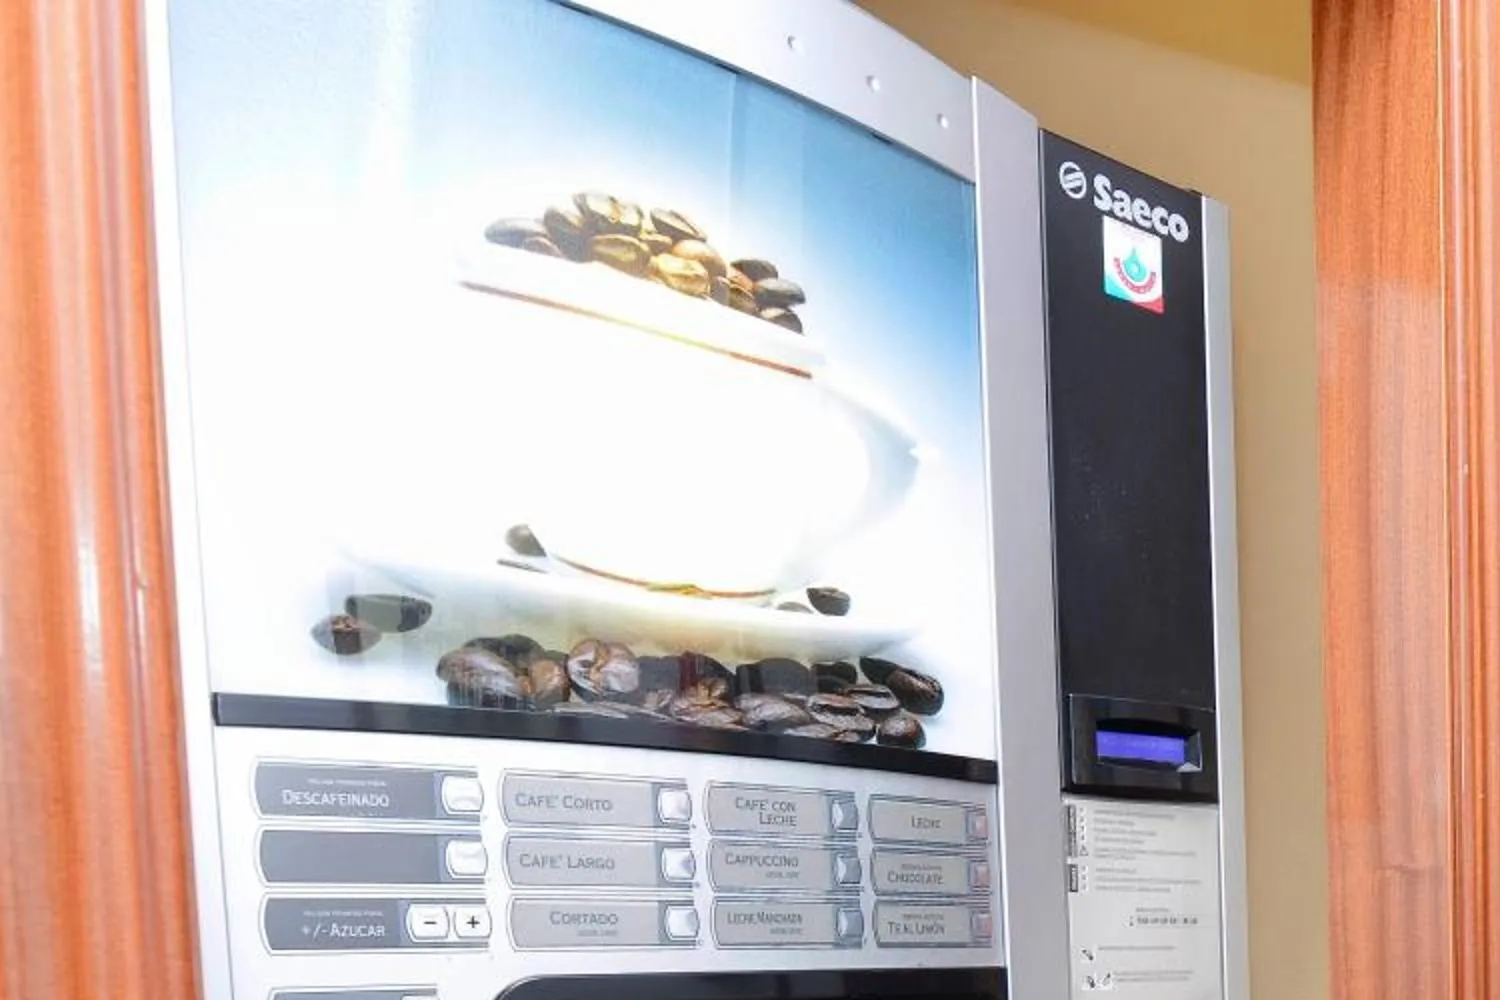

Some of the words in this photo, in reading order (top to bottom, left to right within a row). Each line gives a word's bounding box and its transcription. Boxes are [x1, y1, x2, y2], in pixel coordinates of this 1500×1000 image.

[1093, 173, 1189, 242] Saeco
[282, 789, 390, 807] DESCAFEINADO
[563, 796, 613, 811] CORTO
[759, 812, 797, 827] LECHE
[567, 855, 616, 870] LARGO
[725, 853, 799, 868] CAPPUCCINO
[550, 911, 618, 926] CORTADO
